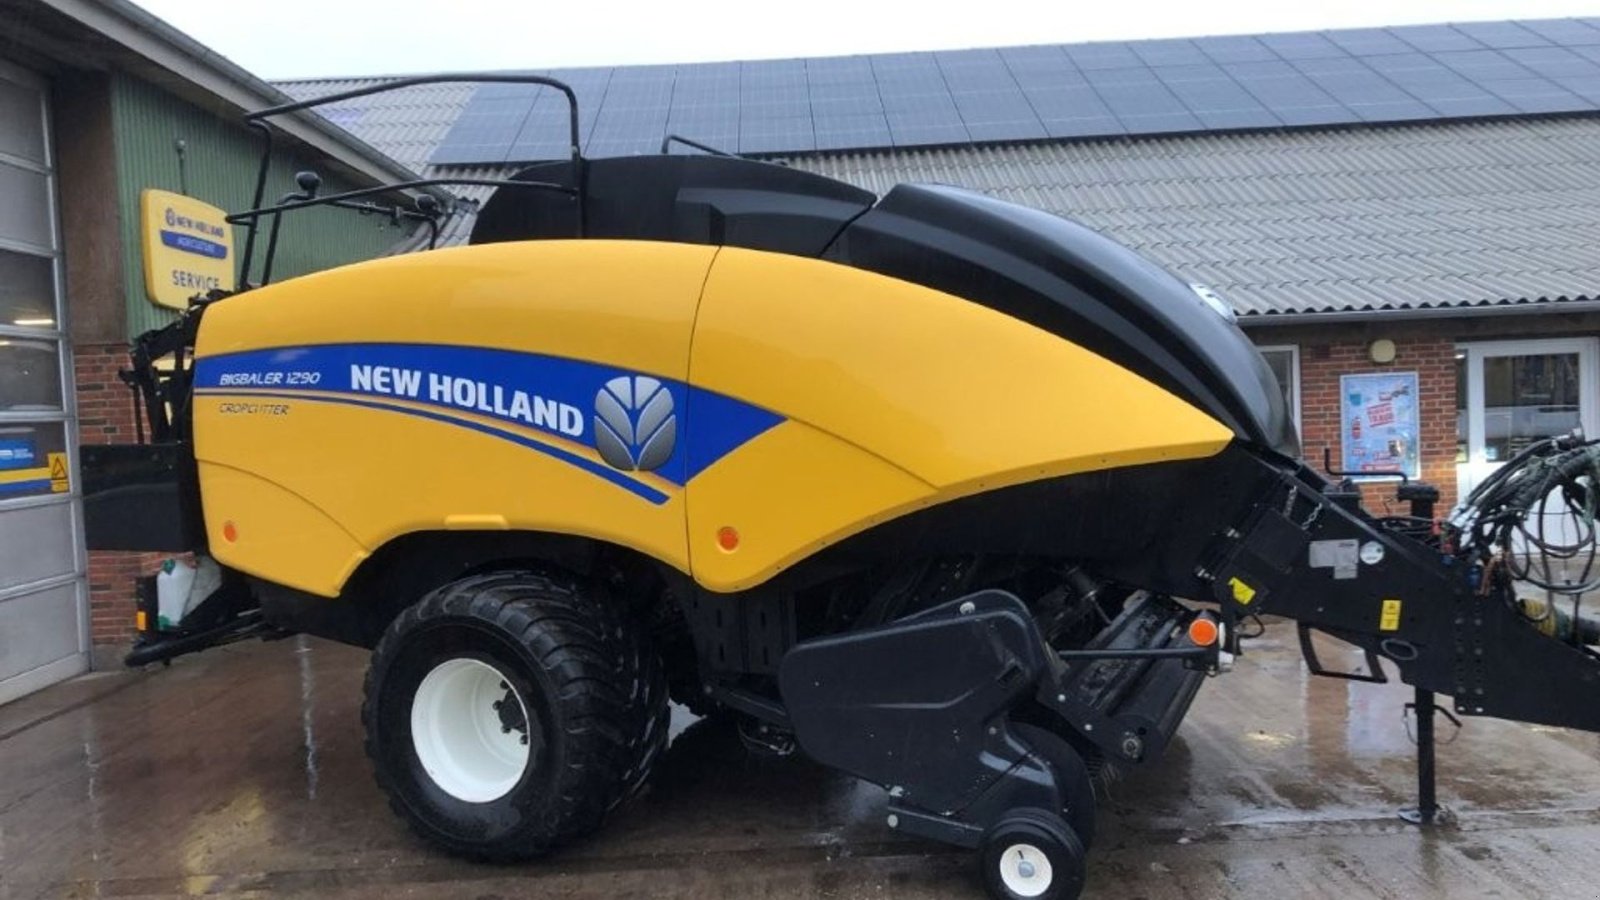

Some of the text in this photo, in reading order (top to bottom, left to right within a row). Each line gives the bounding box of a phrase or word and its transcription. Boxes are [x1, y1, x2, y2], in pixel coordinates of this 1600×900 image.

[172, 270, 219, 288] SERVICE
[220, 372, 321, 386] BIGBALER 1290
[351, 364, 584, 437] NEW HOLLAND
